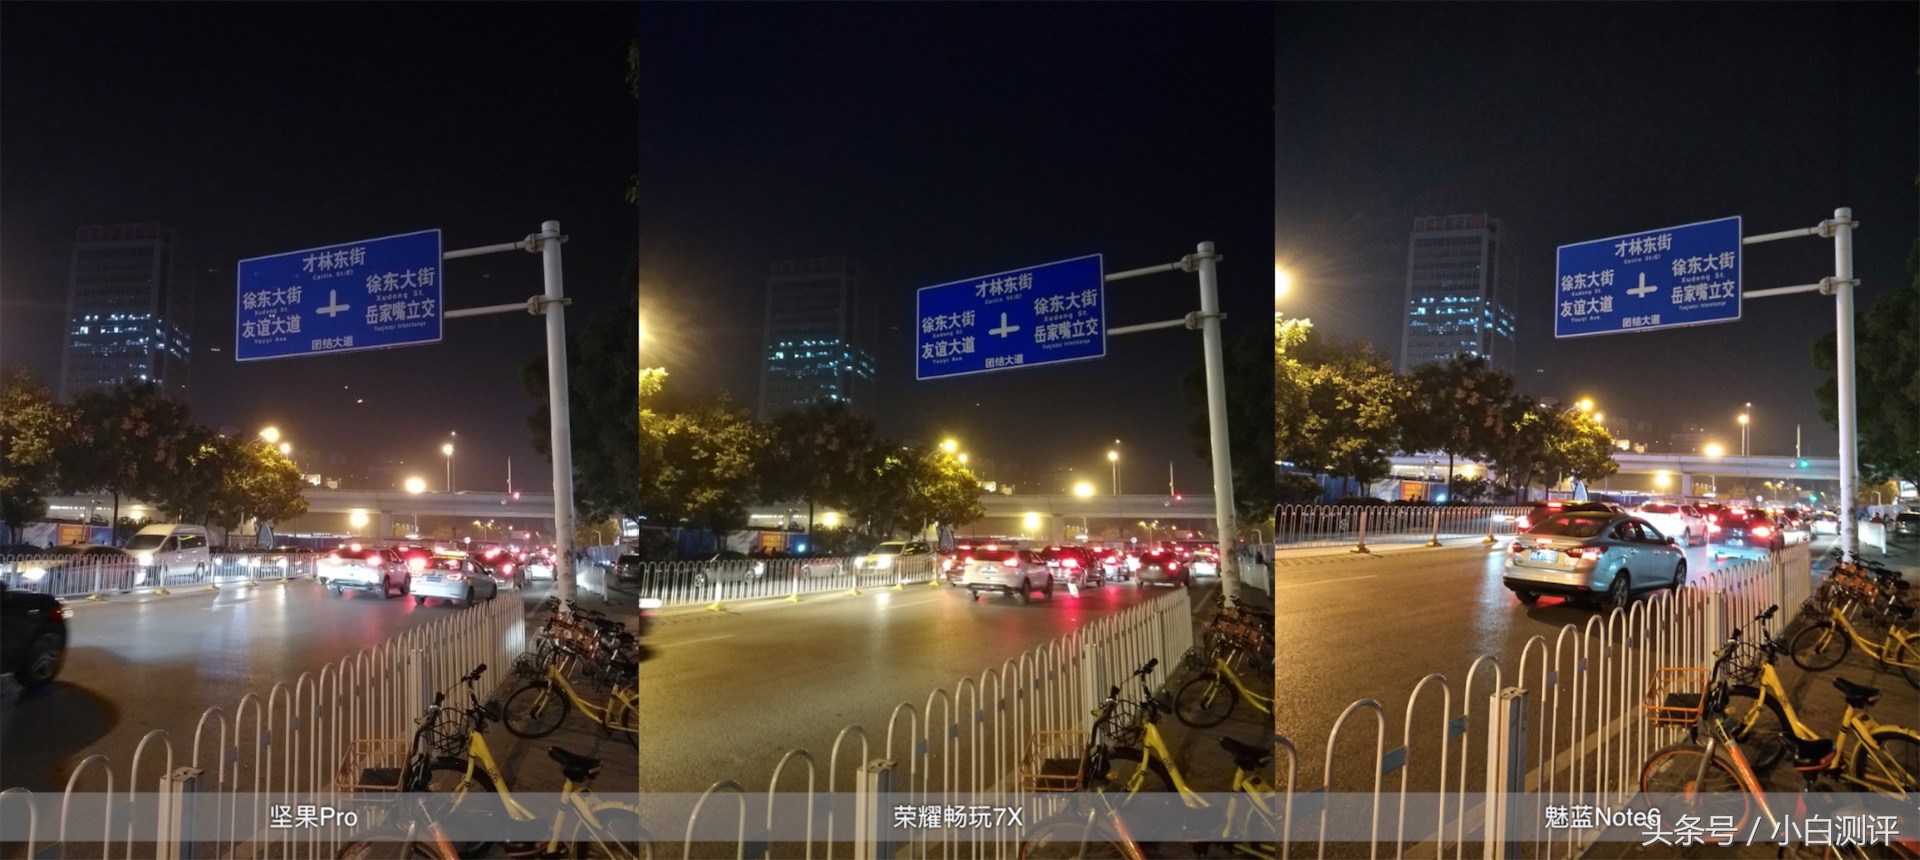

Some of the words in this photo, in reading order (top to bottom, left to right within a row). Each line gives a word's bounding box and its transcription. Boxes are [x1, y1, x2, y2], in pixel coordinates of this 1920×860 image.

[1614, 233, 1673, 258] 才林东街
[302, 247, 366, 273] 才林东街
[1671, 251, 1736, 277] 徐东大街
[365, 267, 435, 294] 徐东大街
[975, 272, 1033, 298] 才林东街
[1561, 269, 1615, 292] 徐东大街
[1680, 274, 1711, 284] Xudong
[242, 286, 302, 310] 徐东大街
[376, 292, 408, 302] Xudong
[1033, 288, 1098, 316] 徐东大街
[1670, 279, 1736, 305] 岳家嘴立交
[365, 298, 436, 325] 岳家嘴立交
[1043, 312, 1074, 322] Xudong
[1560, 295, 1614, 318] 友谊大道
[242, 314, 302, 339] 友谊大道
[921, 309, 976, 334] 徐东大街
[1033, 317, 1099, 343] 岳家嘴立交
[1621, 314, 1662, 329] 团结大道
[311, 336, 354, 351] 团结大道
[921, 336, 976, 360] 友谊大道
[984, 353, 1024, 369] 团结大道
